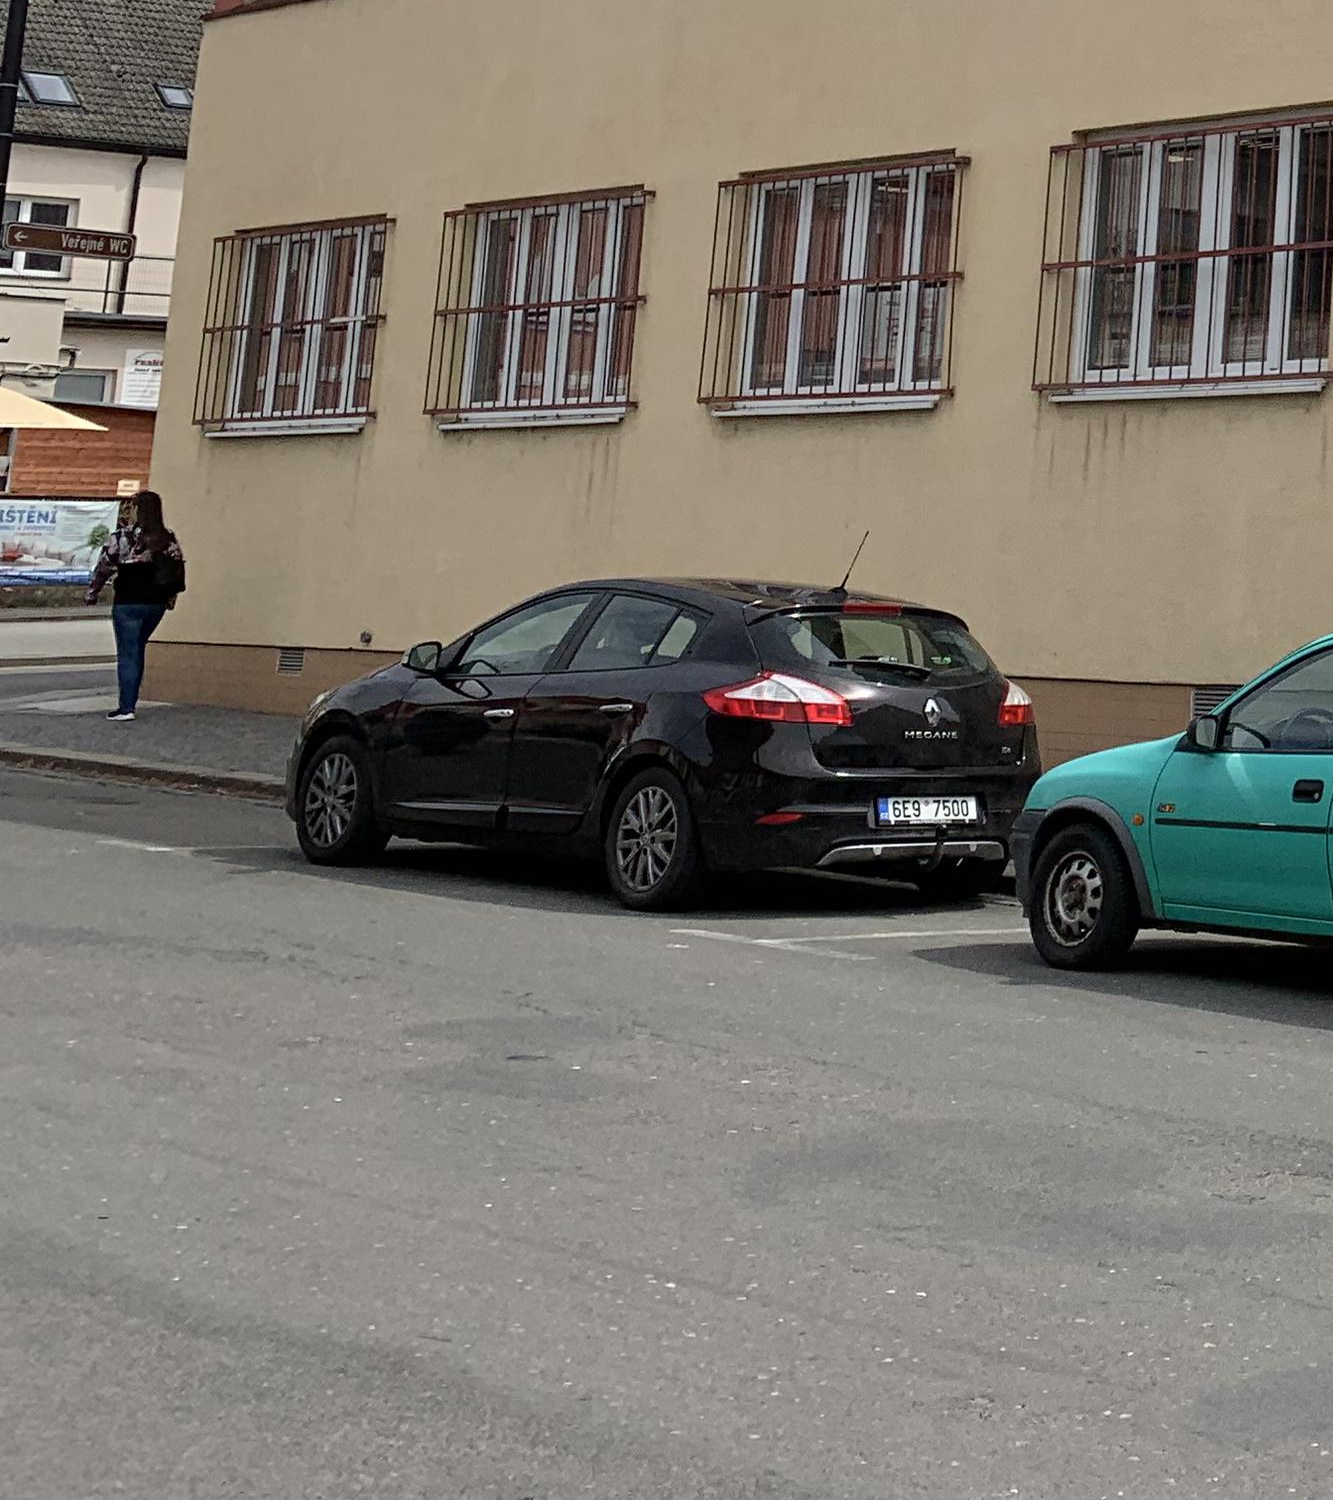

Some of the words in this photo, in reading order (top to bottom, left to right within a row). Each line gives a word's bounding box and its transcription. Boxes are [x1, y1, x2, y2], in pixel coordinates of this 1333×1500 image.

[61, 233, 104, 253] Veřejné
[109, 238, 129, 254] WC
[904, 730, 959, 739] MEGANE
[892, 799, 921, 819] 6E9
[932, 799, 969, 818] 7500
